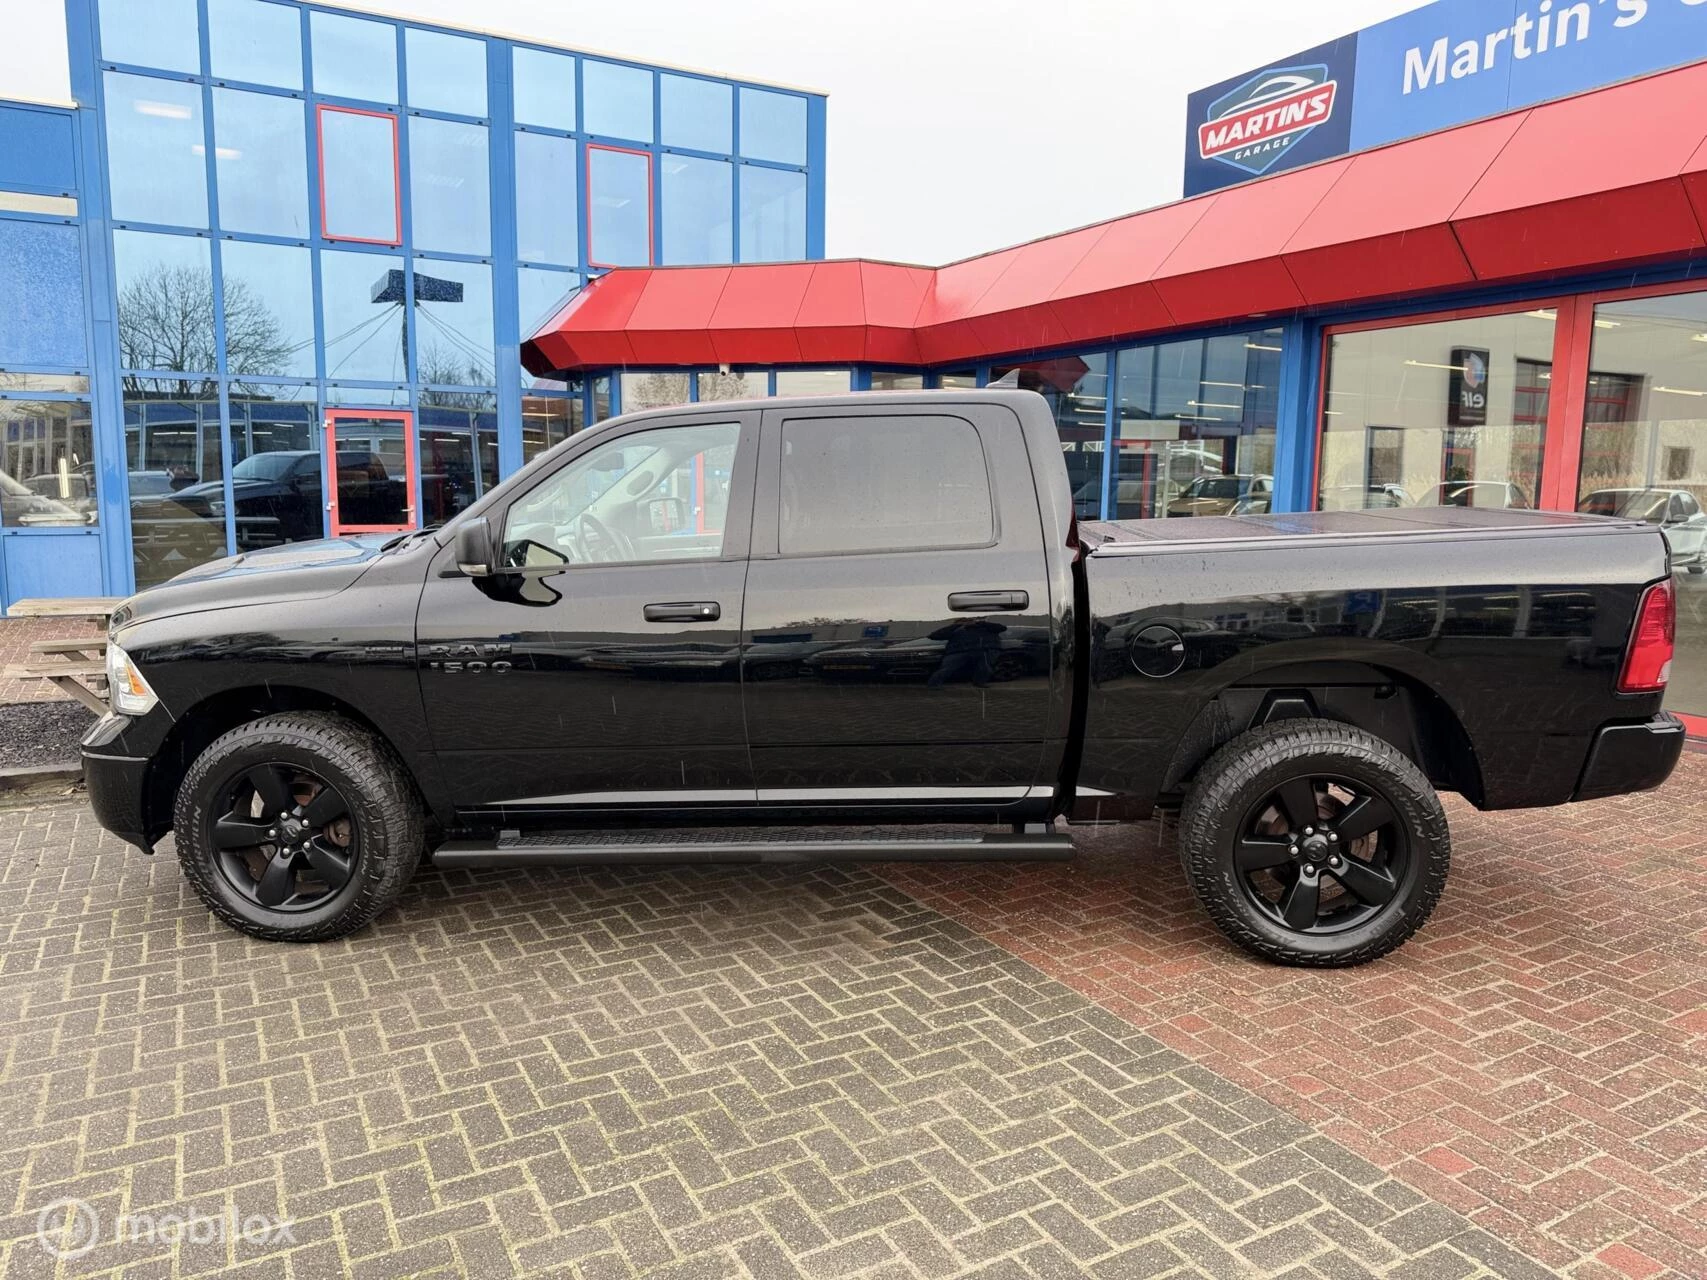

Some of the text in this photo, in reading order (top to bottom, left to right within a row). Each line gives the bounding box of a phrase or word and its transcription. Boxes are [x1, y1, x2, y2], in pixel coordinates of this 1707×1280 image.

[1402, 0, 1648, 95] Martins
[1204, 91, 1330, 150] MARTIN'S
[1234, 136, 1291, 160] GARAGE
[429, 643, 512, 657] RAM
